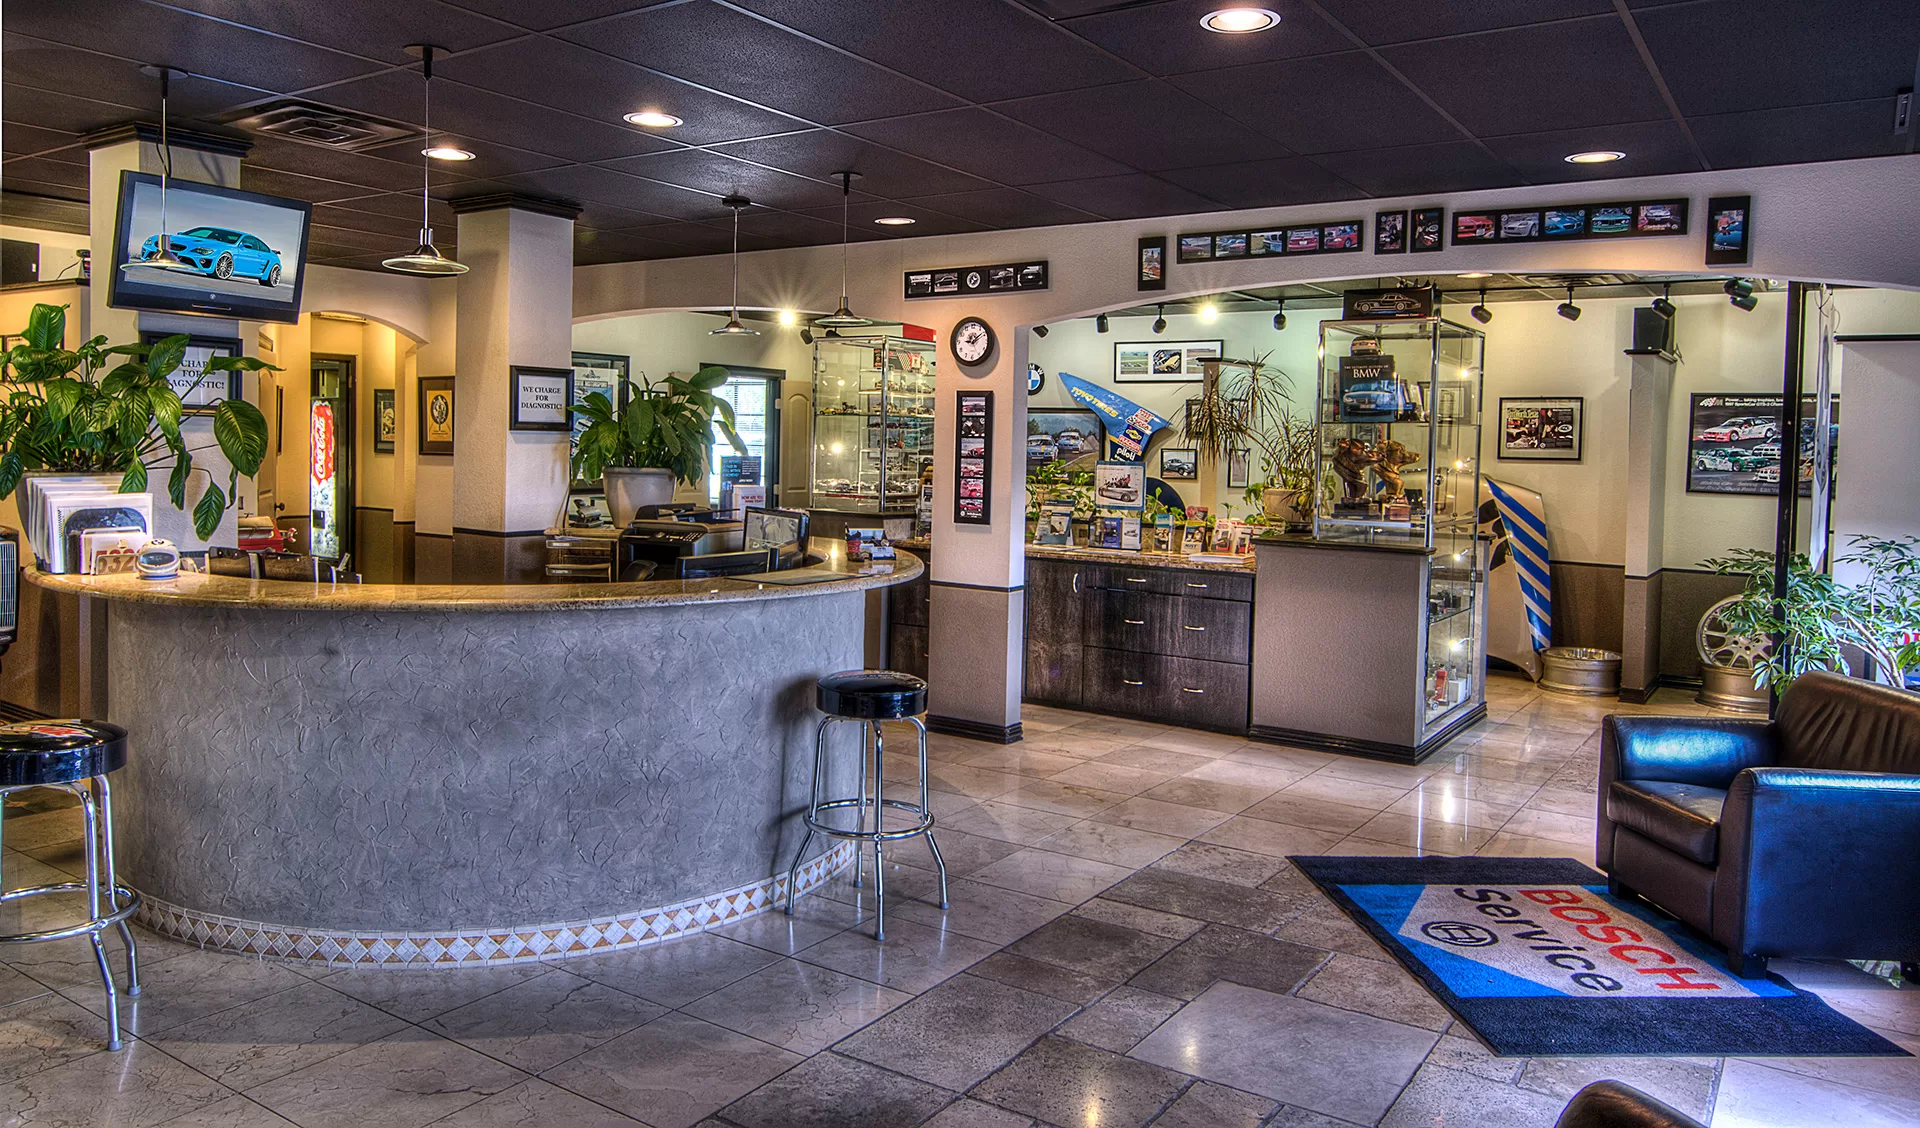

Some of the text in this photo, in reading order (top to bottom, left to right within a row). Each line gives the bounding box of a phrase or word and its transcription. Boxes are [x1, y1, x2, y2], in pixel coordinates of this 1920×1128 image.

[181, 360, 208, 368] CHAR
[1353, 368, 1381, 378] BMW
[172, 379, 225, 389] AGNSTIC!
[534, 386, 562, 394] CHARGE
[521, 402, 563, 410] DIAGNOSTIC!
[1092, 398, 1119, 418] TIRES
[1453, 887, 1624, 993] Service
[1516, 889, 1722, 991] BOSCH
